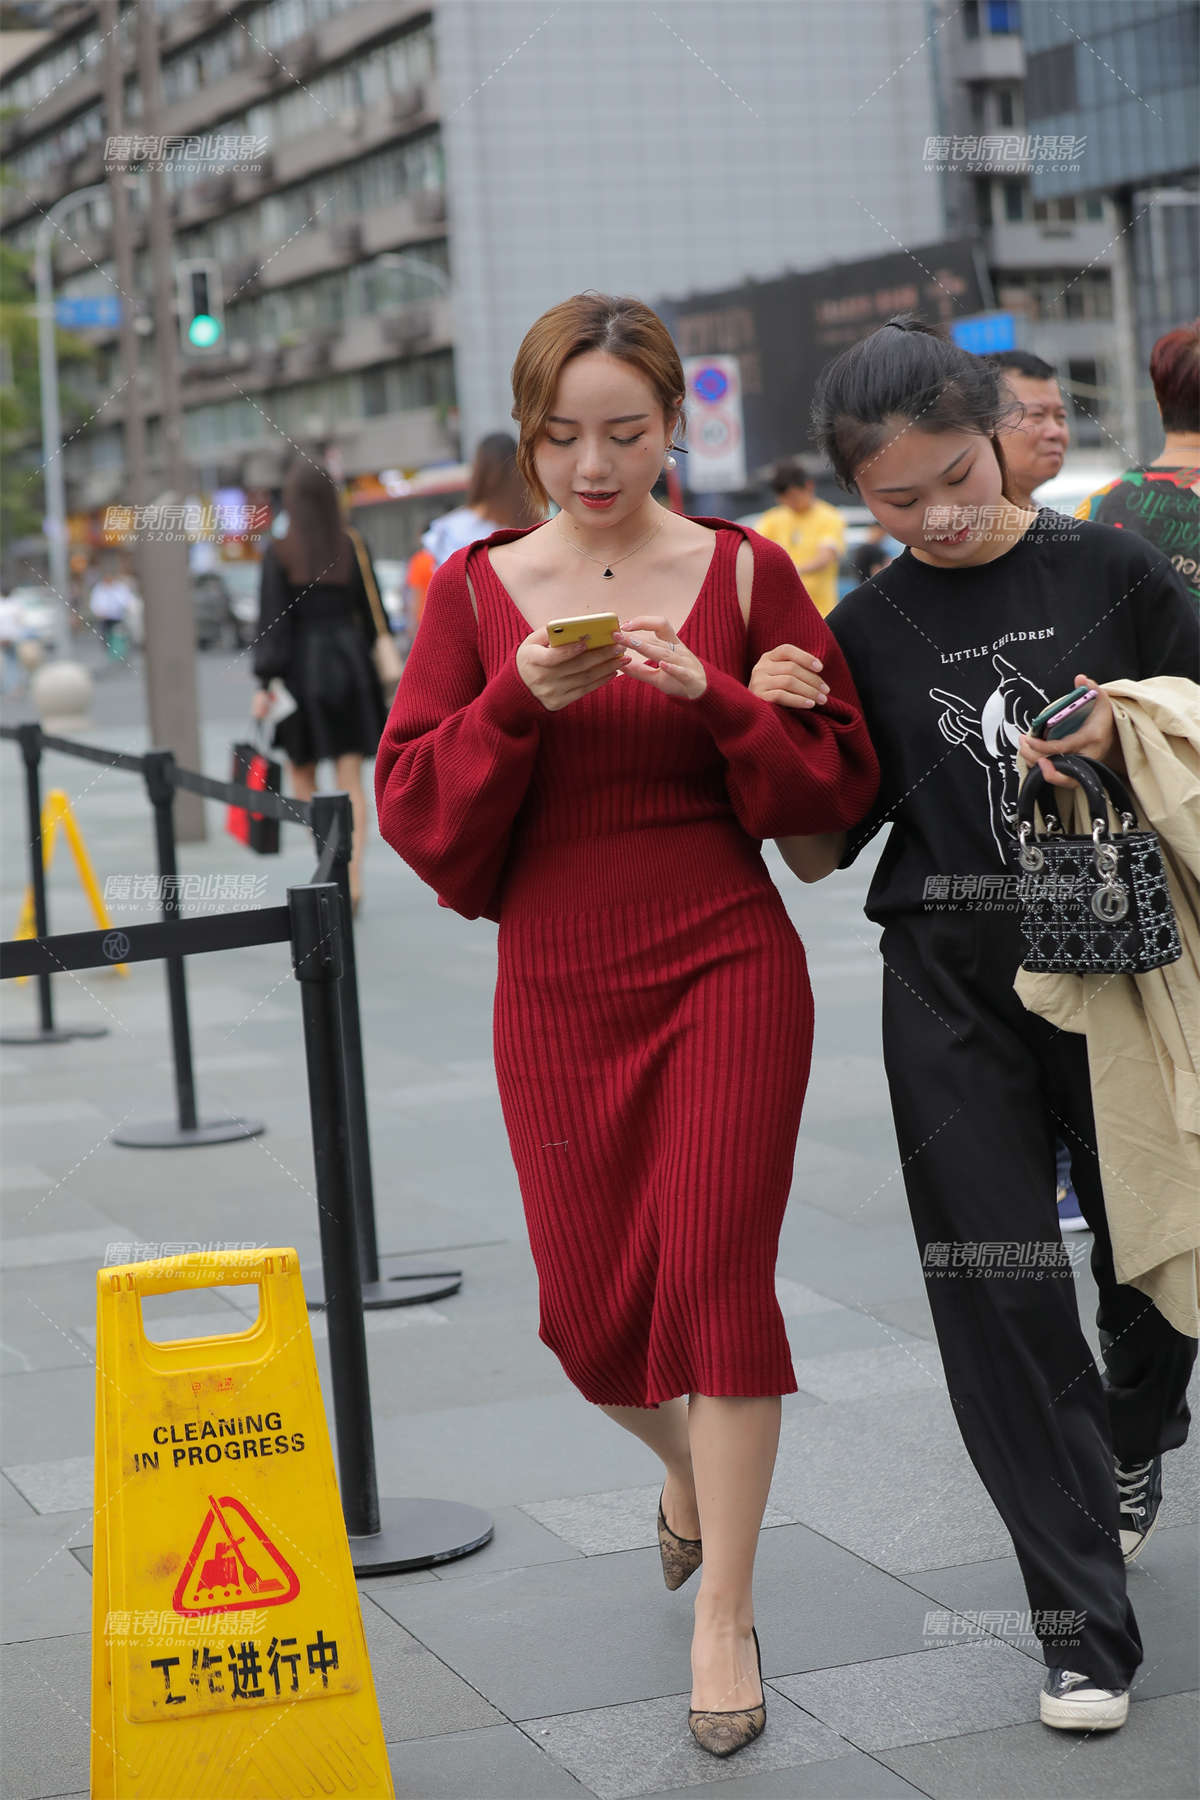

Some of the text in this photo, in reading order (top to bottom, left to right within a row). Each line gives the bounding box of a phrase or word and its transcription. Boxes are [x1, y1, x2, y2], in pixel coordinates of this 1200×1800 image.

[941, 627, 1055, 664] LITTLE CHILDREN
[153, 1412, 282, 1445] CLEANING
[134, 1433, 305, 1472] IN PROGRESS
[150, 1629, 339, 1706] 工作进行中
